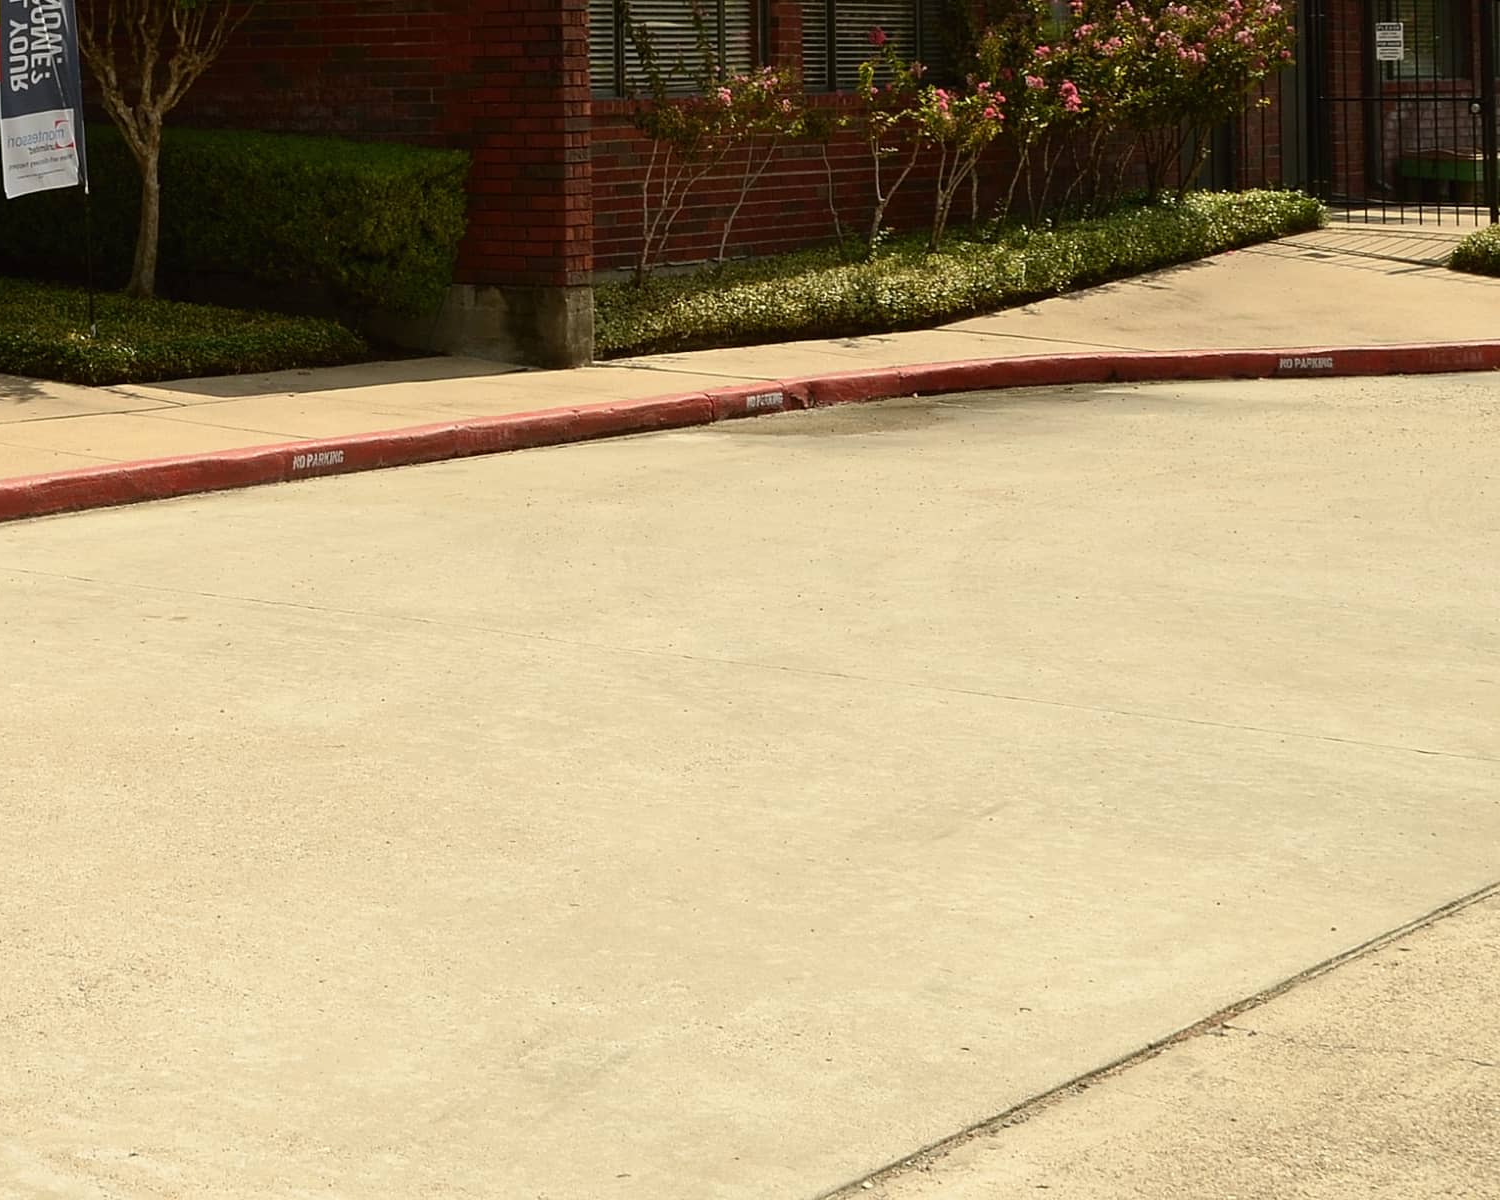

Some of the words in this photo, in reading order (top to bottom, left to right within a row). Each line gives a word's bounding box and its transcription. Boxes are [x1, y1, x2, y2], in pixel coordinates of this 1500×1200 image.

[1279, 358, 1293, 368] NO
[1294, 357, 1333, 368] PARKING
[292, 454, 306, 470] NO
[306, 450, 344, 468] PARKING
